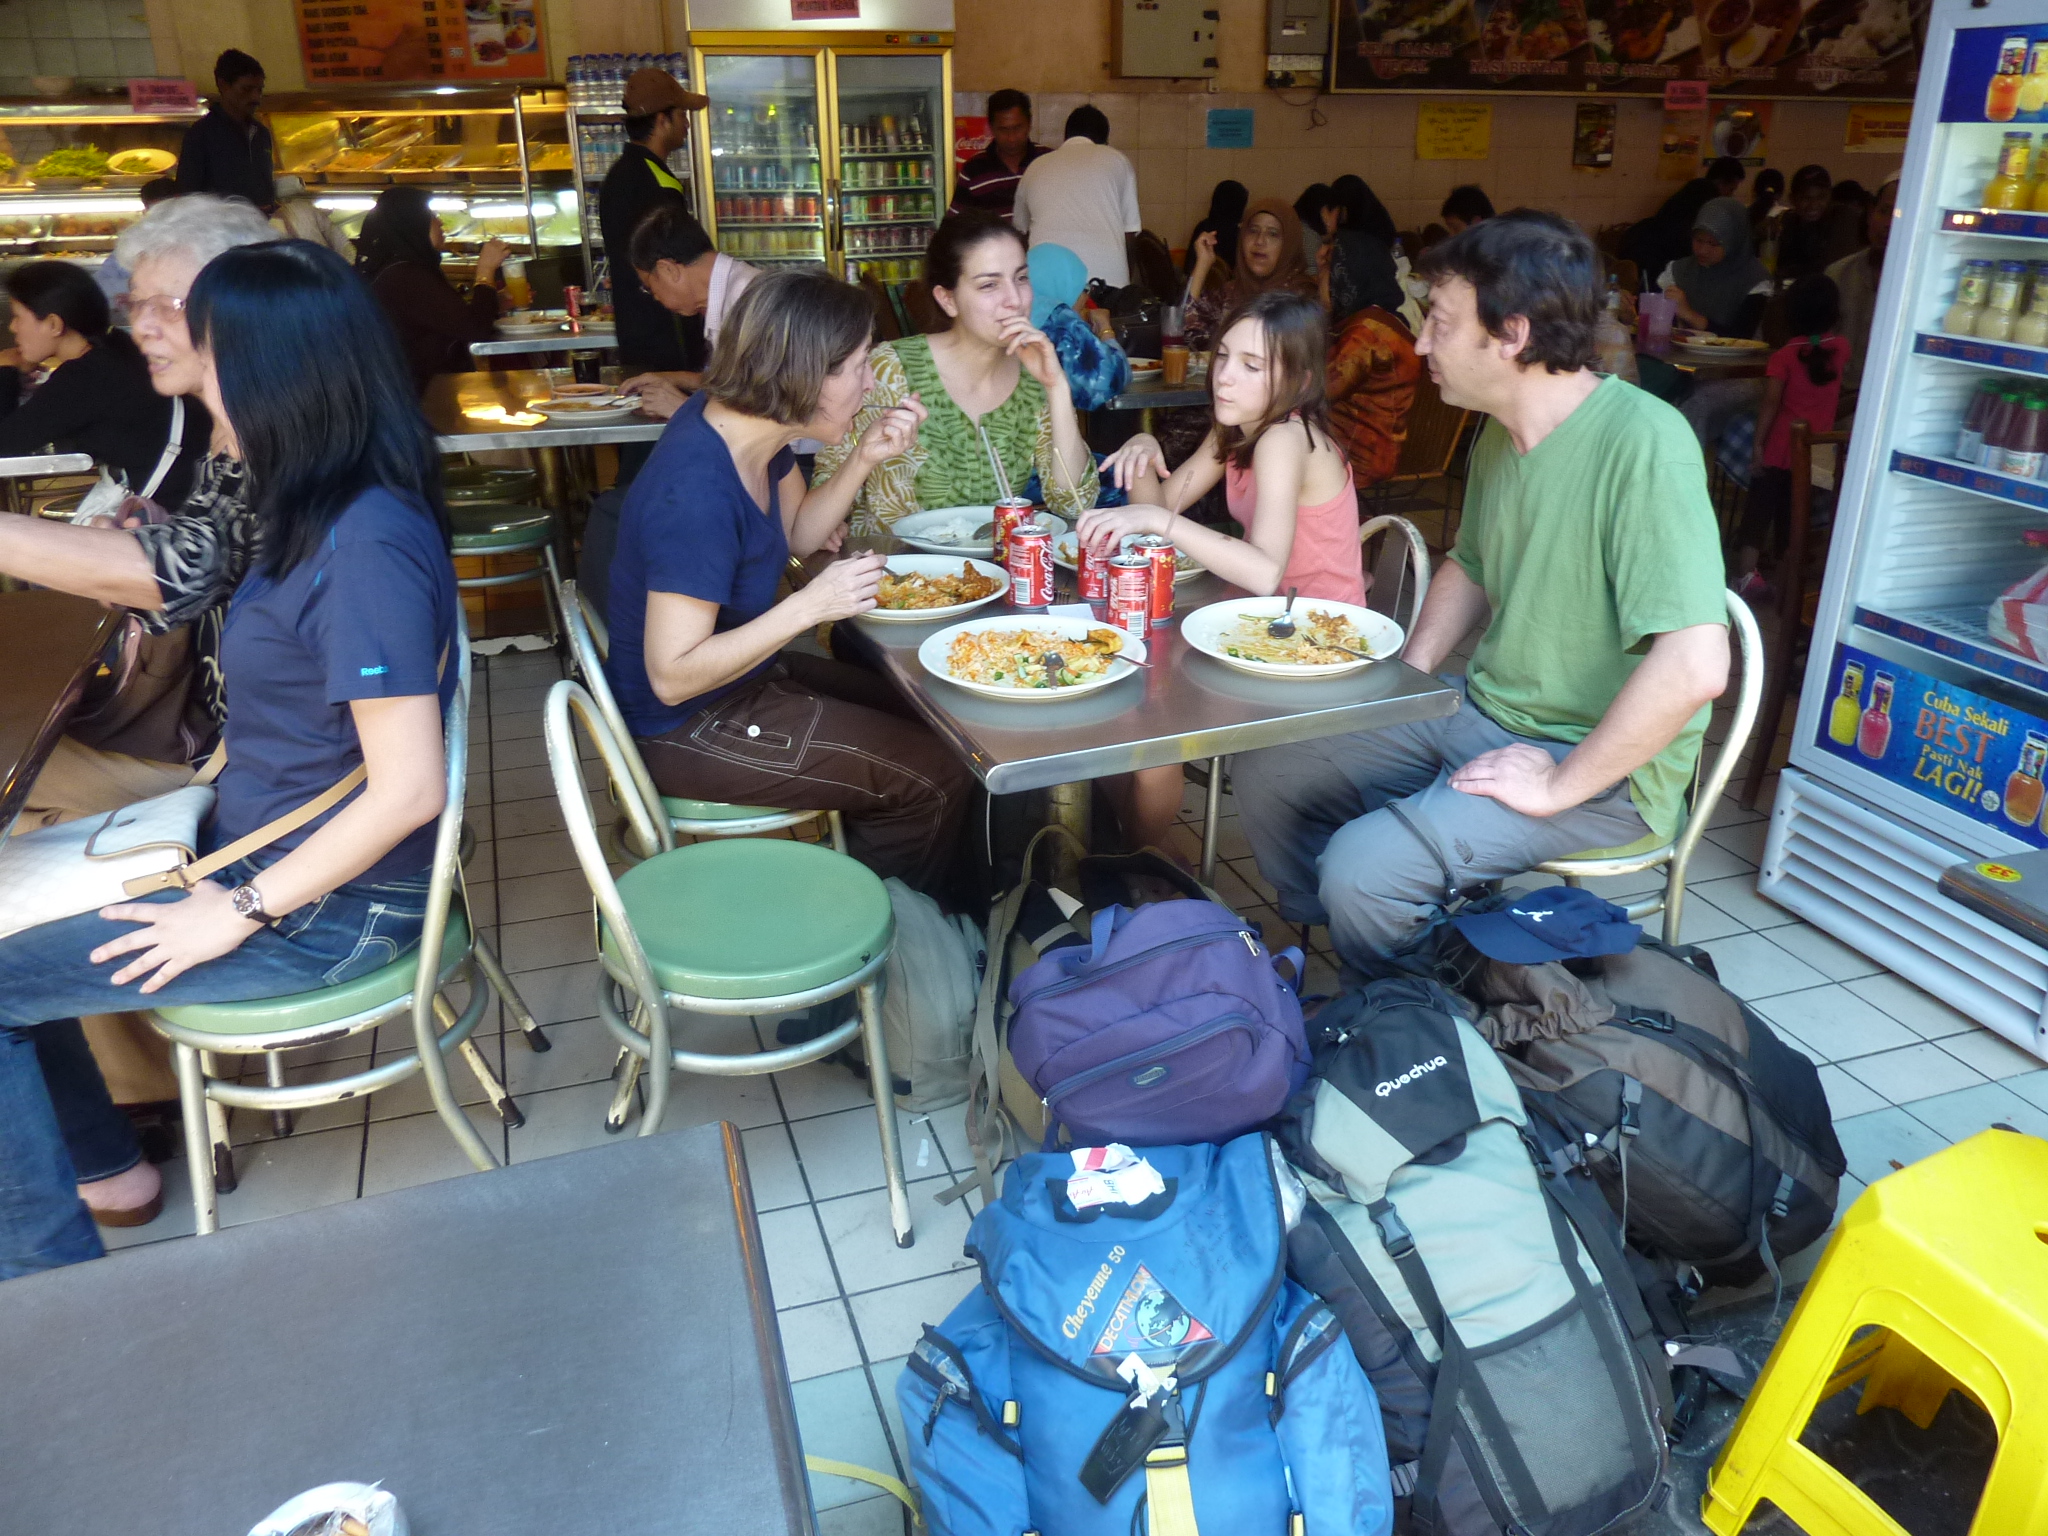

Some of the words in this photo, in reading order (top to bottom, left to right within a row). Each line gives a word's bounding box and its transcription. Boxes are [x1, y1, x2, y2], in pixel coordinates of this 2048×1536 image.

[1915, 708, 1996, 764] BEST
[1923, 691, 1961, 717] Cuba
[1964, 706, 2010, 736] Sekali
[1913, 757, 1983, 803] LAGI!
[1921, 744, 1954, 767] Pasti
[1957, 758, 1984, 780] Nak
[1375, 1055, 1448, 1097] Quechua
[1061, 1263, 1114, 1340] Cheyenne
[1108, 1244, 1127, 1264] 50
[1099, 1269, 1153, 1352] DECATHLON
